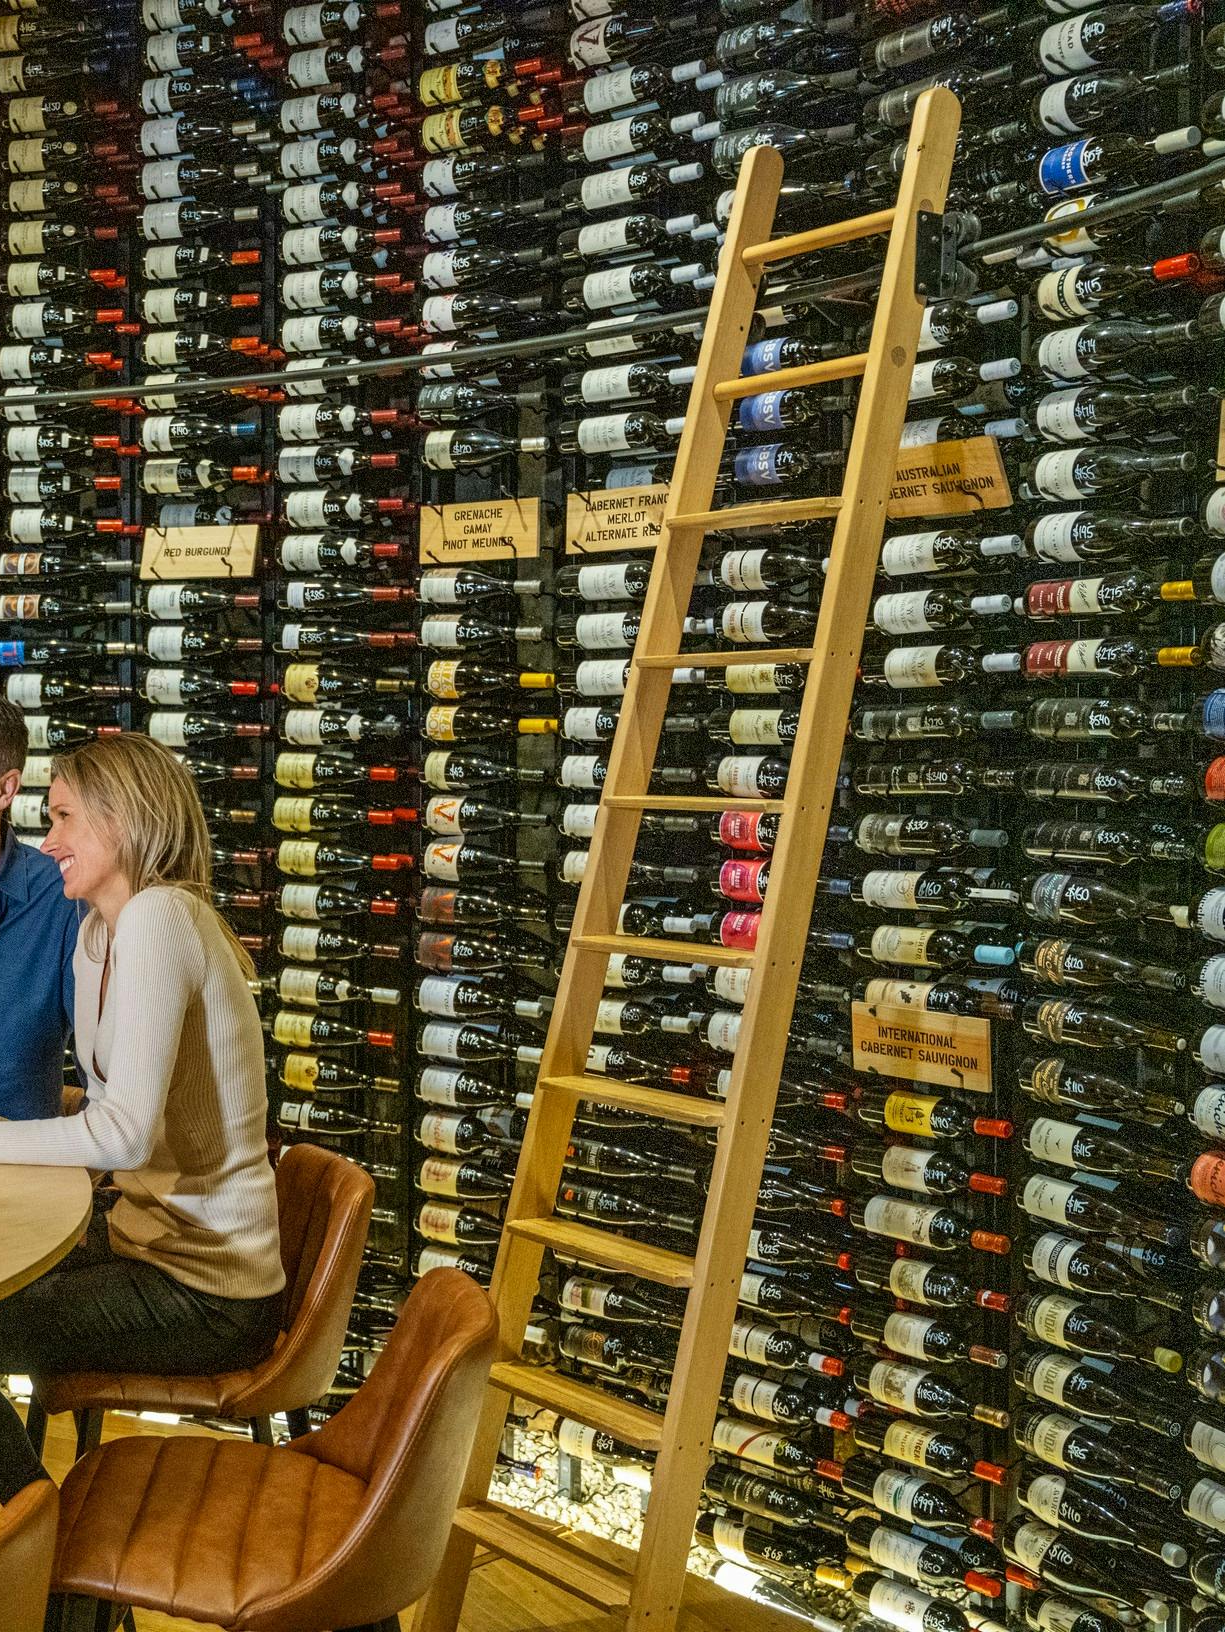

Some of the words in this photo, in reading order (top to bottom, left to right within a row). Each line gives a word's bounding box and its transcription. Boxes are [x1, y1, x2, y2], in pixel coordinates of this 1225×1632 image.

[1072, 80, 1099, 99] $129
[1075, 277, 1102, 295] $115
[896, 463, 961, 482] AUSTRALIAN
[888, 484, 928, 500] ERNET
[454, 508, 503, 521] GRENACHE
[607, 510, 646, 525] MERLOT
[463, 522, 492, 535] GAMAY
[585, 527, 638, 542] ALTERNATE
[1072, 524, 1094, 539] $195
[163, 548, 182, 558] RED
[184, 546, 232, 556] BURGUNDY
[442, 539, 468, 550] PINOT
[1098, 585, 1124, 603] $275
[1095, 647, 1120, 661] $275
[1089, 711, 1111, 728] $540
[1095, 774, 1117, 787] $330
[1097, 830, 1121, 844] $330
[878, 1025, 957, 1050] INTERNATIONAL
[860, 1040, 914, 1060] CABERNET
[918, 1050, 978, 1070] SAUVIGNON
[1064, 1079, 1085, 1093] $110
[759, 1242, 780, 1256] $225
[1143, 1251, 1166, 1266] $65
[1069, 1260, 1090, 1277] $65
[773, 1400, 789, 1415] $60
[596, 1435, 614, 1451] $69
[1059, 1504, 1081, 1523] $110
[762, 1546, 783, 1561] $68
[1048, 1544, 1073, 1566] $110
[918, 1557, 941, 1574] $850
